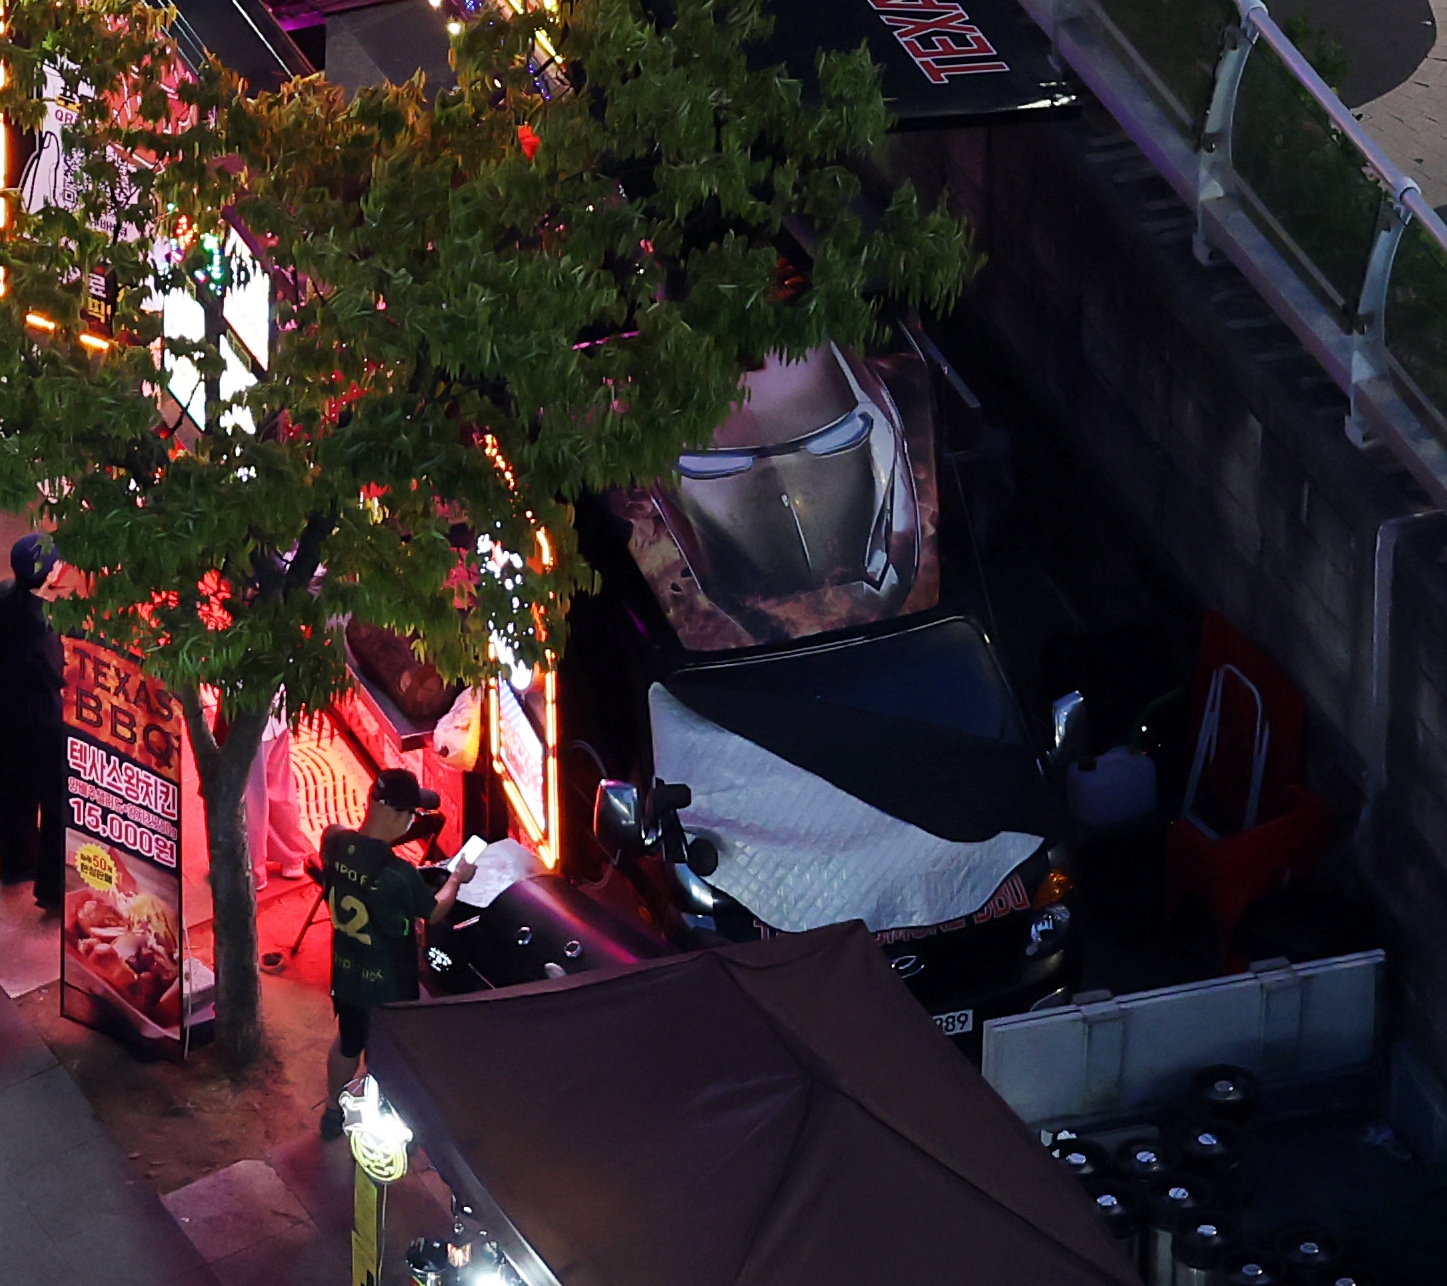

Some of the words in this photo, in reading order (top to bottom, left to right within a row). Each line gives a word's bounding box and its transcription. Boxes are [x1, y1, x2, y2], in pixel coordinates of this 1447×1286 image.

[72, 647, 174, 722] TEXAS
[75, 685, 179, 769] BBQ
[67, 736, 178, 821] 텍사스왕치킨
[68, 797, 177, 868] 15,000원
